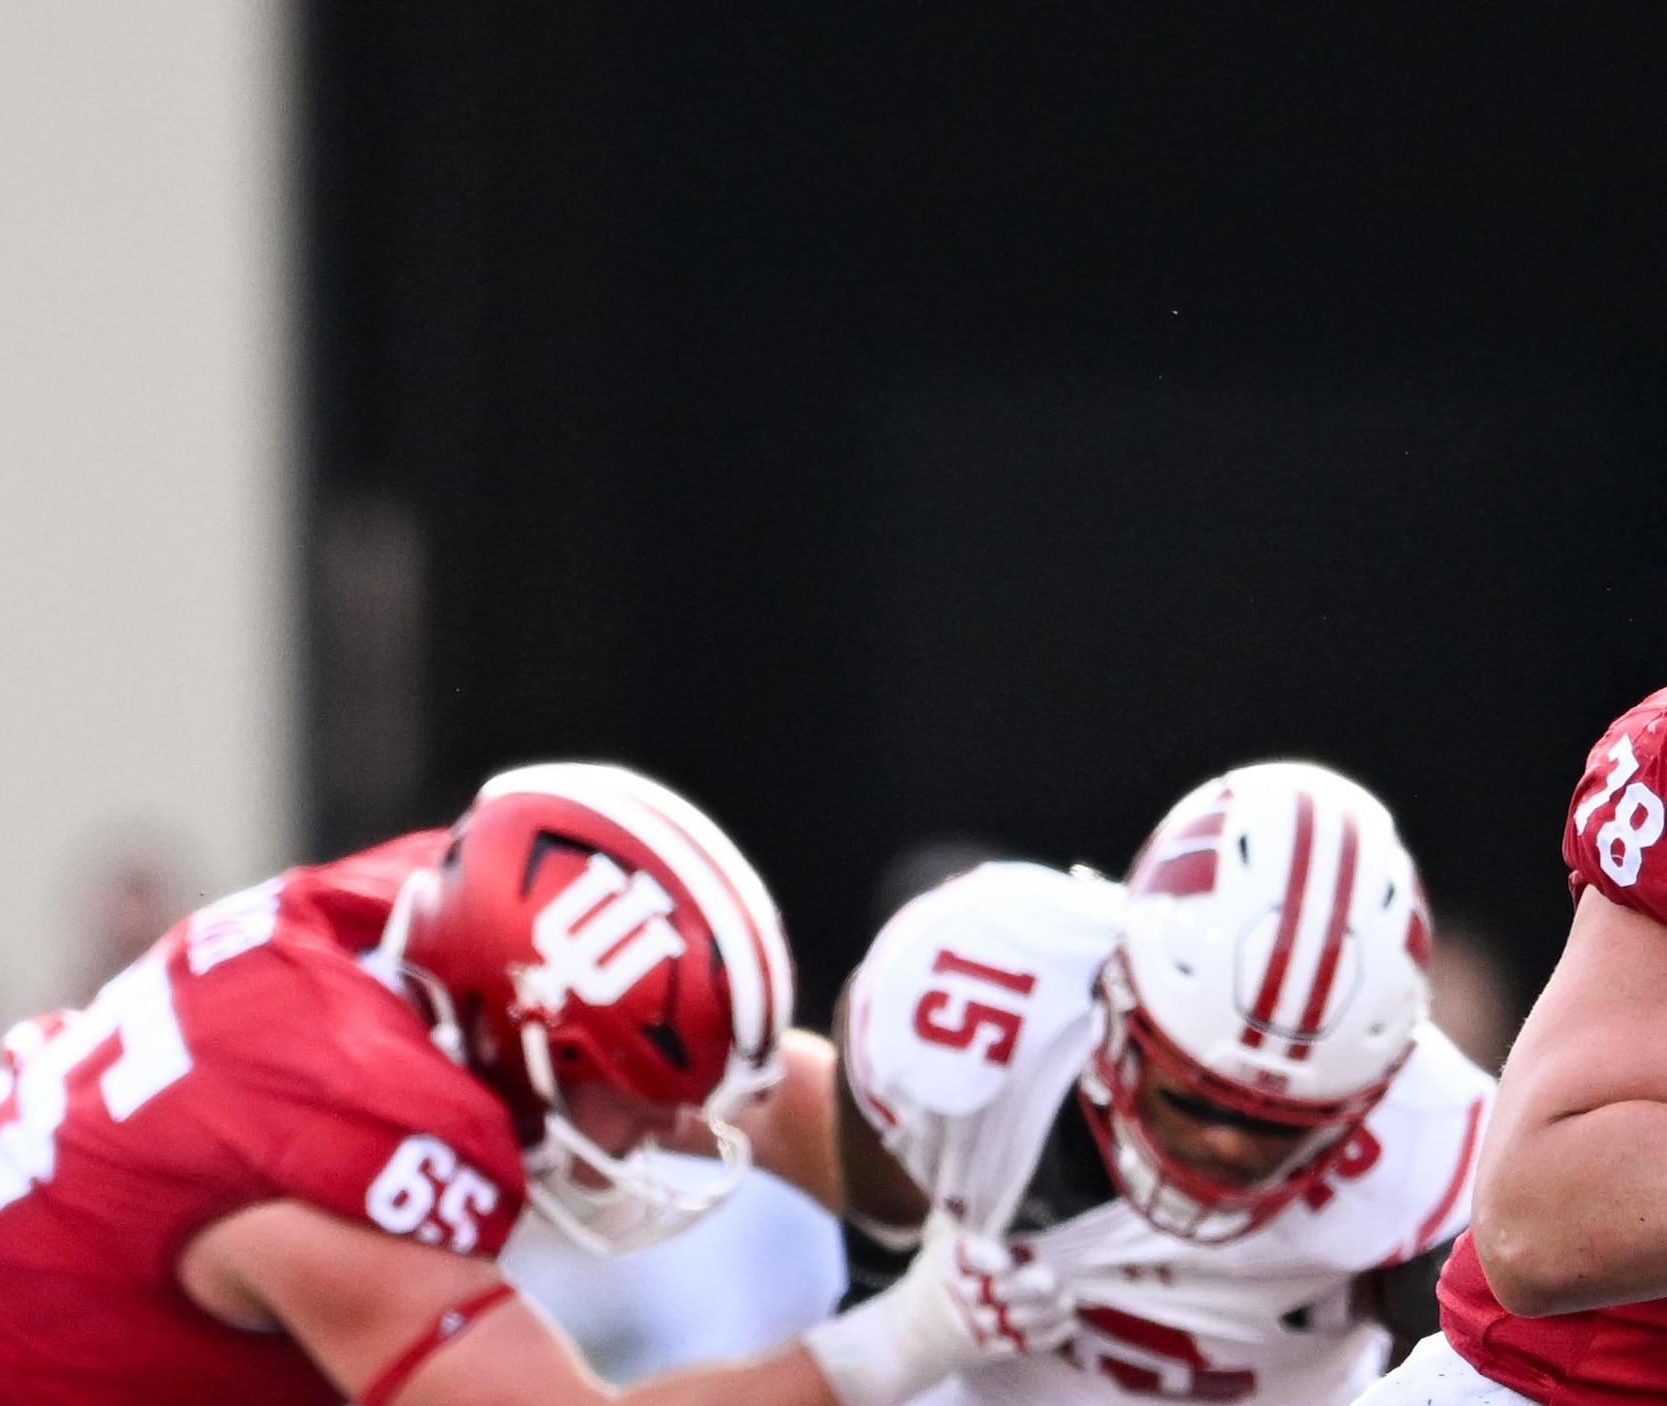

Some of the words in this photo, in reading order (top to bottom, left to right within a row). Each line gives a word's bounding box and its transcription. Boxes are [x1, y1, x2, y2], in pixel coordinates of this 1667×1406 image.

[1573, 732, 1666, 889] 78
[912, 948, 1038, 1068] 15
[364, 1134, 499, 1253] 65
